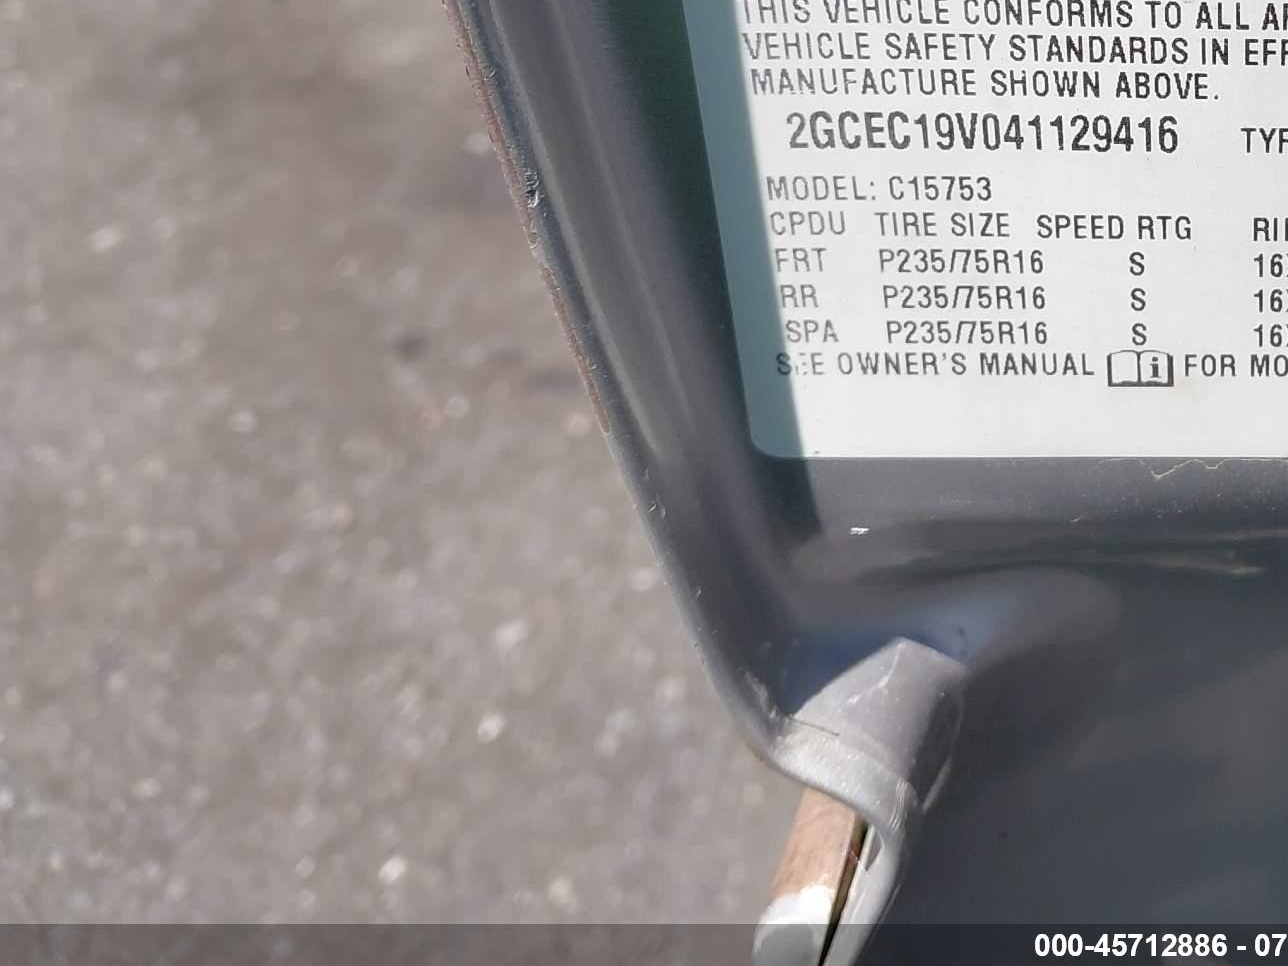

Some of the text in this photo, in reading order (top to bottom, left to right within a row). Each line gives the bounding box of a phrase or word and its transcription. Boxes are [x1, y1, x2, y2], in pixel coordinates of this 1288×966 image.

[964, 0, 1132, 27] CONFORMS
[1145, 1, 1181, 28] TO
[1196, 1, 1249, 30] ALL
[742, 33, 870, 59] VEHICLE
[885, 34, 995, 60] SAFETY
[1009, 36, 1188, 65] STANDARDS
[1201, 39, 1229, 65] IN
[751, 69, 1219, 100] MANUFACTURE SHOWN ABOVE.
[787, 111, 1178, 153] 2GCEC19V041129416
[767, 176, 991, 201] MODEL: C15753
[771, 212, 1192, 240] CPDU TIRE SIZE SPEED RTG
[775, 249, 827, 272] FRT
[879, 249, 1044, 274] P235/75R16
[1129, 253, 1145, 276] S
[781, 285, 818, 307] RR
[883, 286, 1045, 310] P235/75R16
[1131, 288, 1146, 311] S
[786, 321, 839, 343] SPA
[887, 321, 1047, 345] P235/75R16
[1132, 323, 1147, 346] S
[839, 353, 966, 376] OWNER'S
[980, 353, 1095, 377] MANUAL
[1185, 355, 1236, 377] FOR
